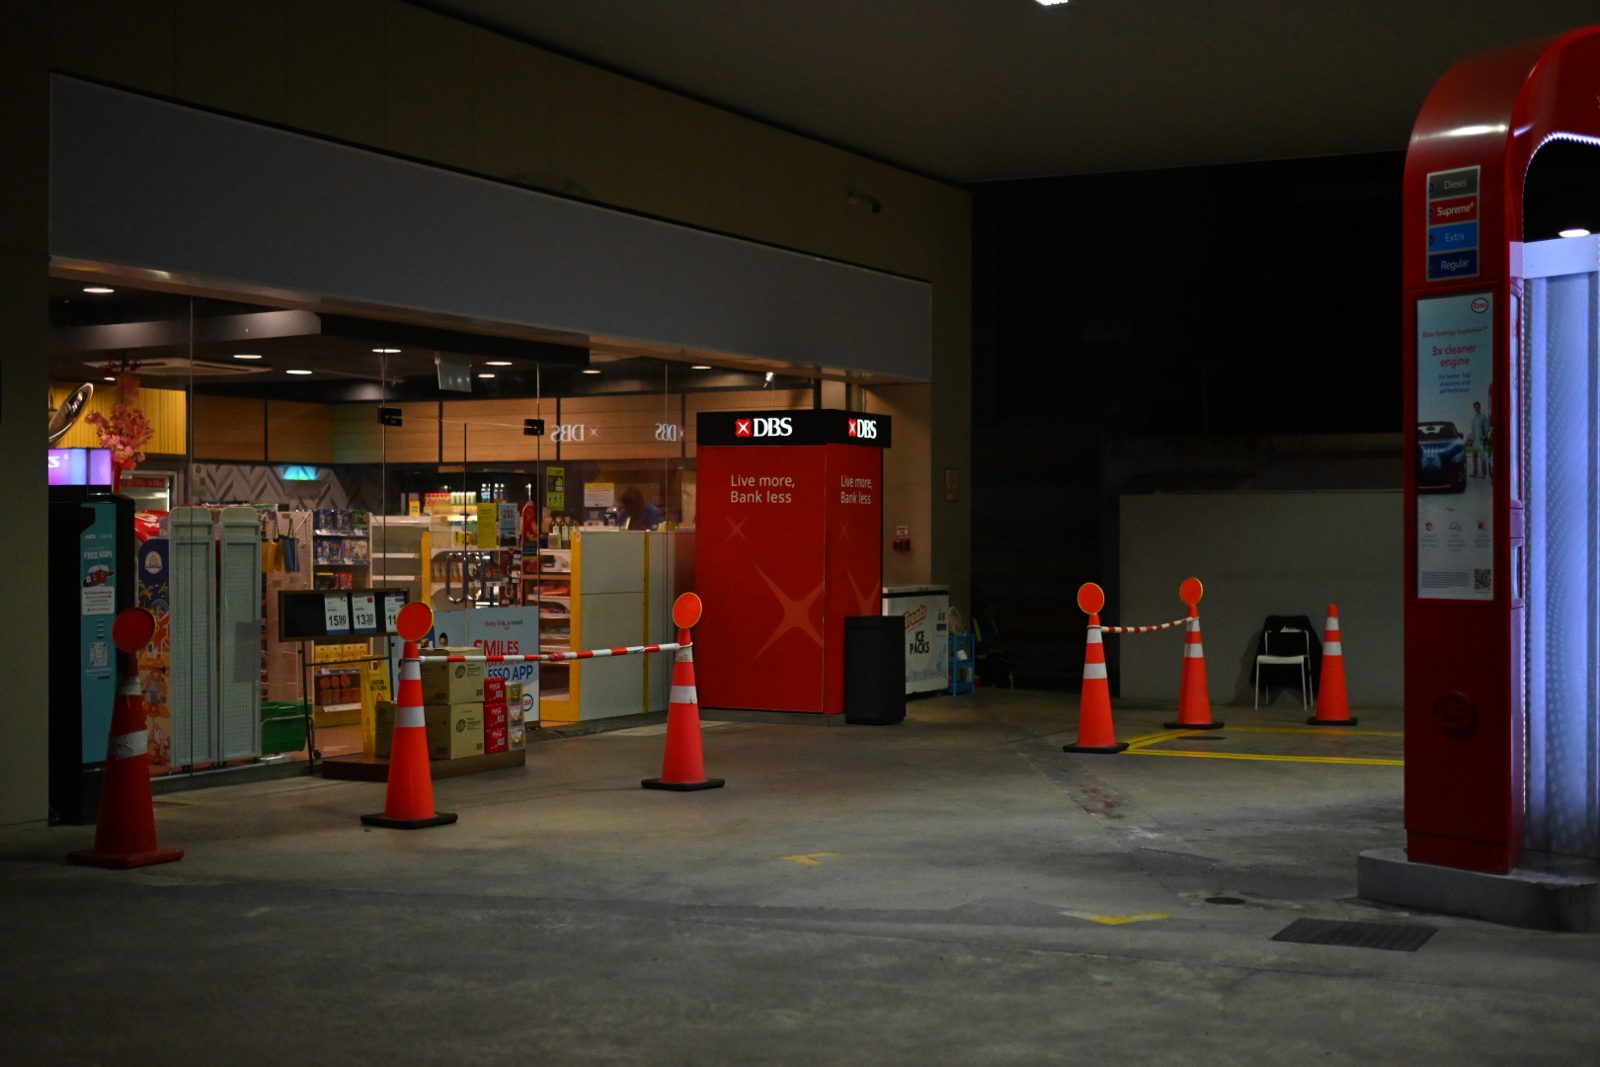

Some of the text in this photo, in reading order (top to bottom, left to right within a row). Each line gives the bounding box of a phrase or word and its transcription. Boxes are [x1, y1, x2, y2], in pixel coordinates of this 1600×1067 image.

[1443, 178, 1467, 190] Diesel
[1445, 231, 1465, 242] Extra
[1440, 259, 1469, 271] Regular
[1432, 345, 1477, 357] 3x cleaner
[1440, 357, 1471, 369] engine
[753, 417, 793, 438] DBS
[857, 418, 878, 440] DBS
[731, 474, 795, 489] Live more,
[841, 474, 873, 490] Live more,
[731, 490, 792, 503] Bank less
[841, 491, 871, 504] Bank less
[916, 630, 925, 642] ICE
[910, 642, 930, 656] PACKS
[488, 667, 511, 681] ESSO
[513, 664, 534, 680] APP
